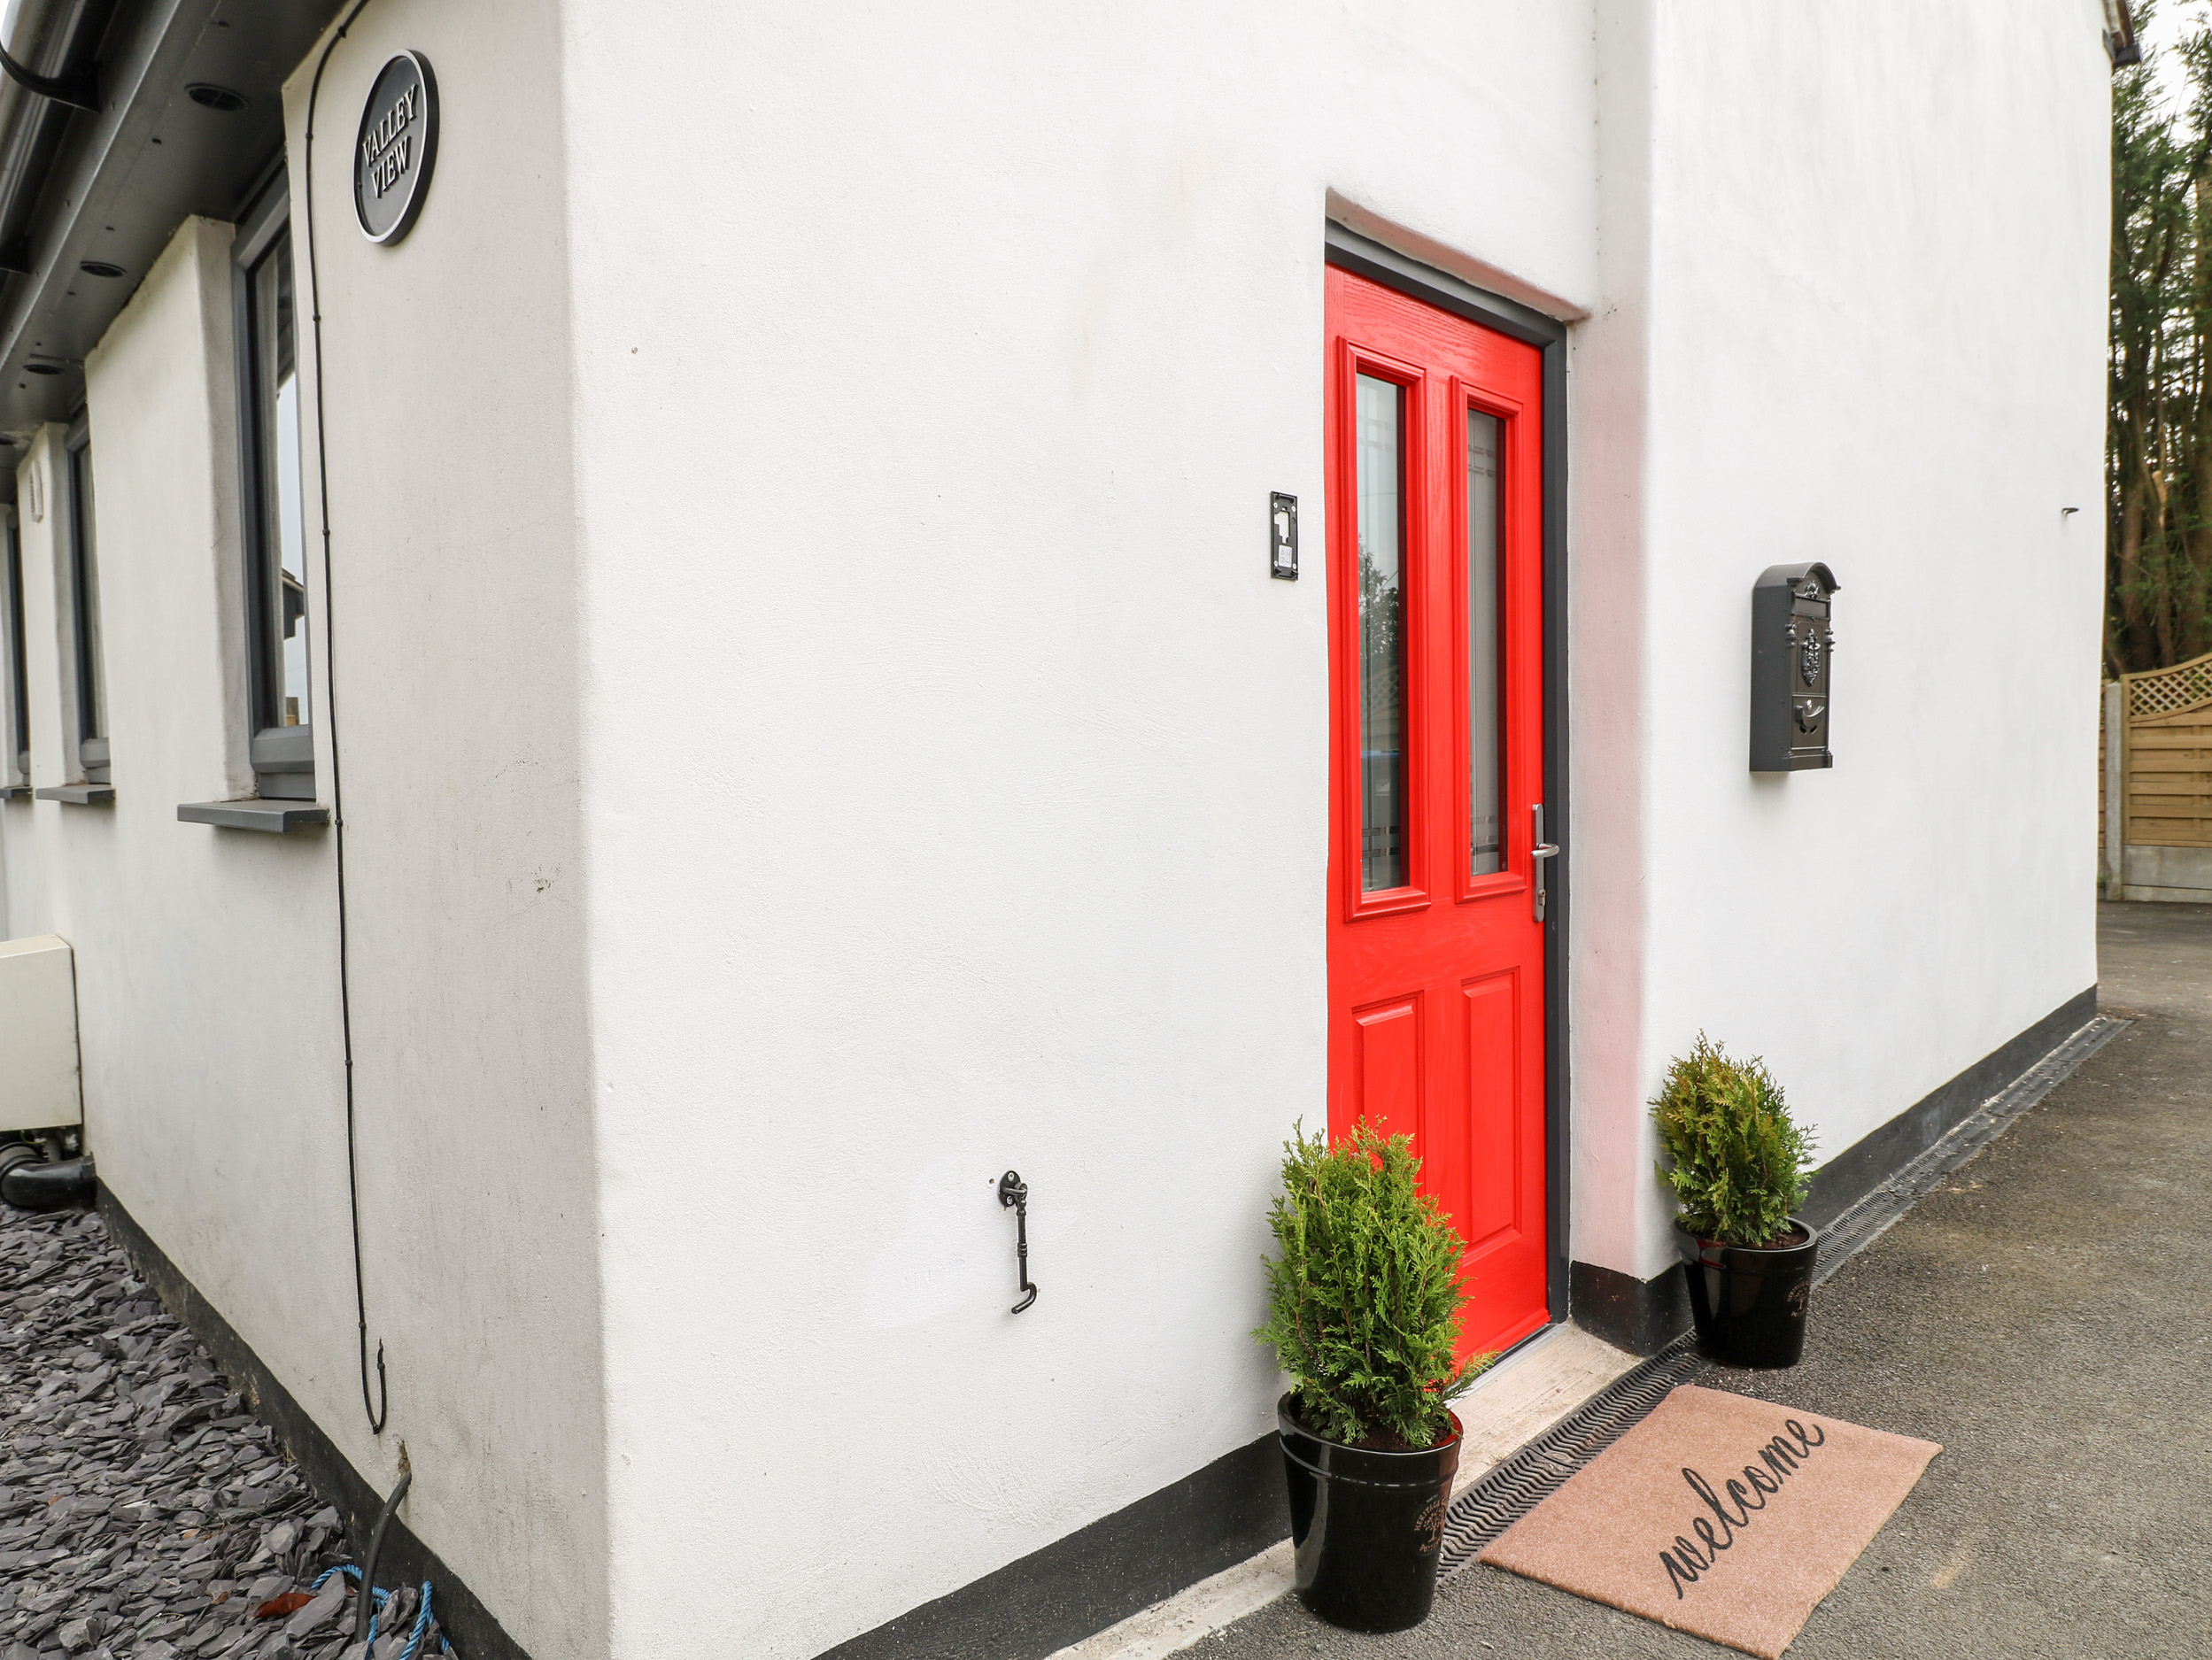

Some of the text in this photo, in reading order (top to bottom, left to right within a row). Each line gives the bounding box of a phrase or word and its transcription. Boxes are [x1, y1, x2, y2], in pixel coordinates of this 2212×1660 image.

[362, 83, 418, 167] VALLEY
[371, 135, 411, 198] VIEW
[1659, 1419, 1824, 1600] welcome
